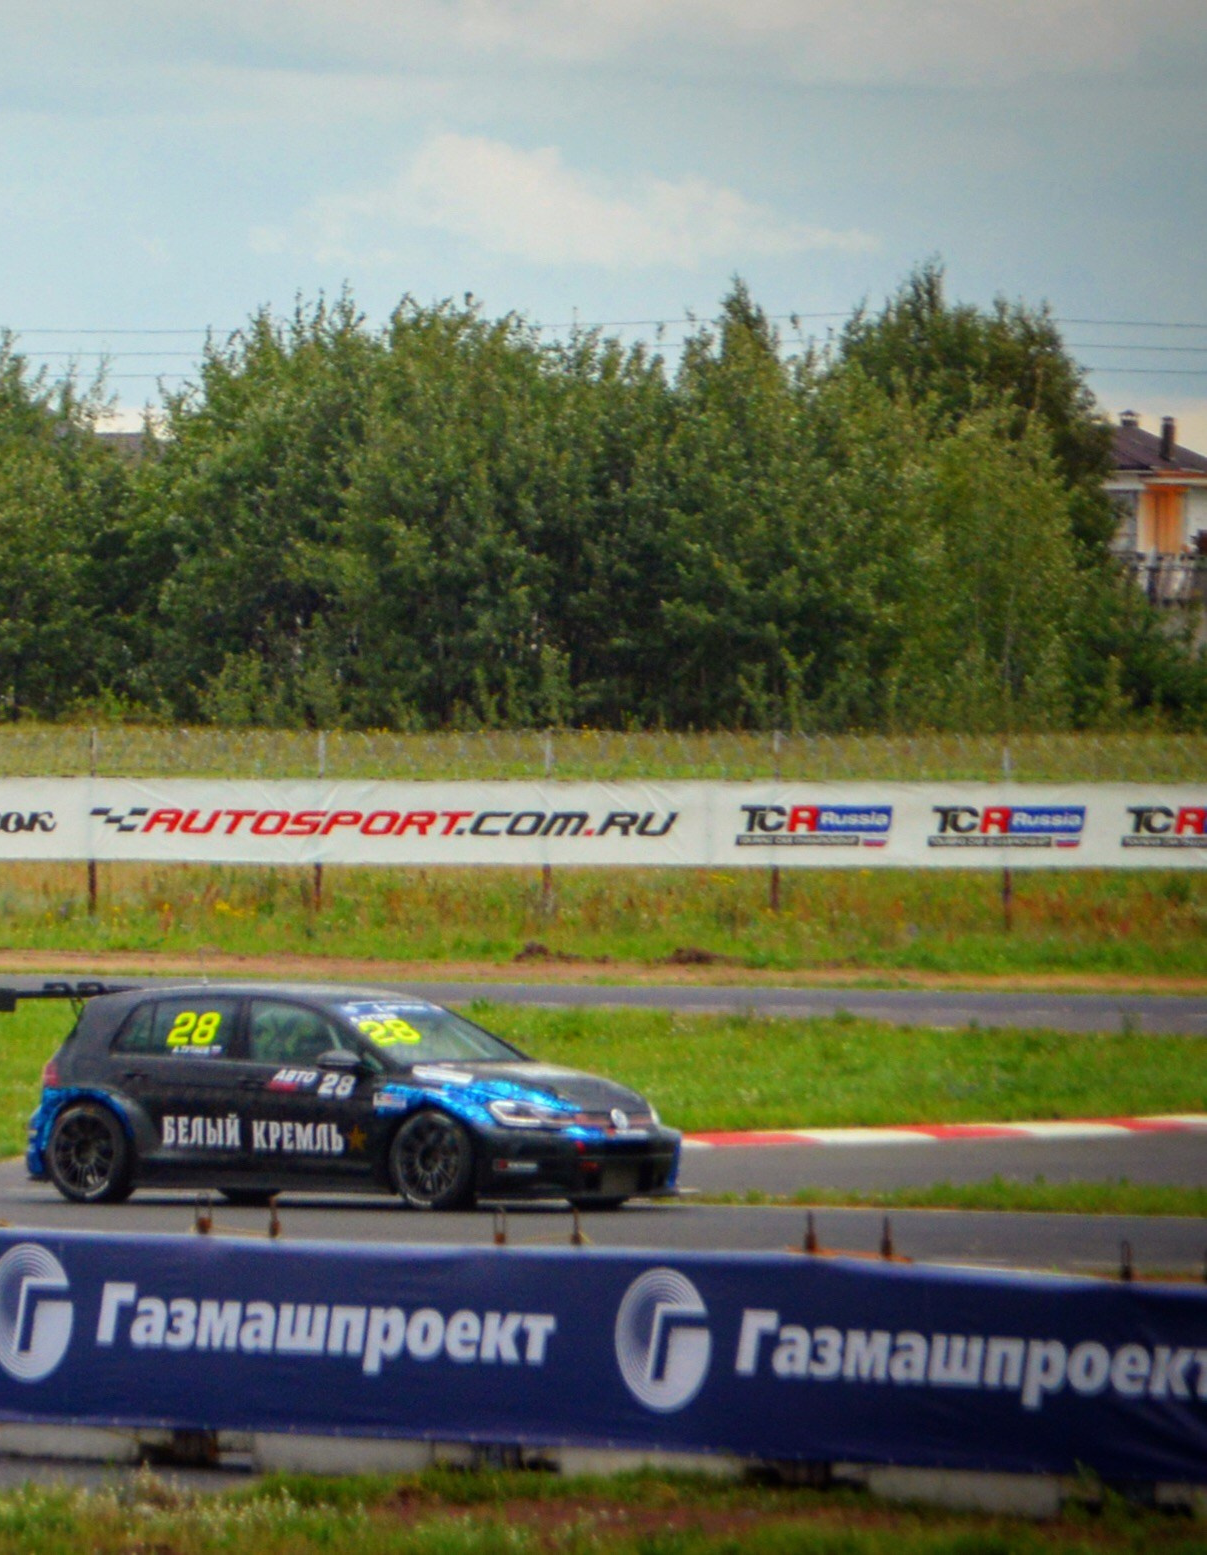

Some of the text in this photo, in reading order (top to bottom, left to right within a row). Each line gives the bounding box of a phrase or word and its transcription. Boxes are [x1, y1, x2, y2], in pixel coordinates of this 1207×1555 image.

[141, 808, 678, 836] AUTOSPORT.COM.RU
[740, 805, 889, 832] TCR Russia
[932, 806, 1081, 834] TCR Russia
[1126, 806, 1206, 834] TCR
[167, 1011, 221, 1046] 28
[358, 1020, 420, 1046] 28
[317, 1073, 356, 1098] 28
[162, 1114, 344, 1152] БЕЛЫЙ КРЕМЛЬ
[96, 1281, 557, 1376] Газмашпроект
